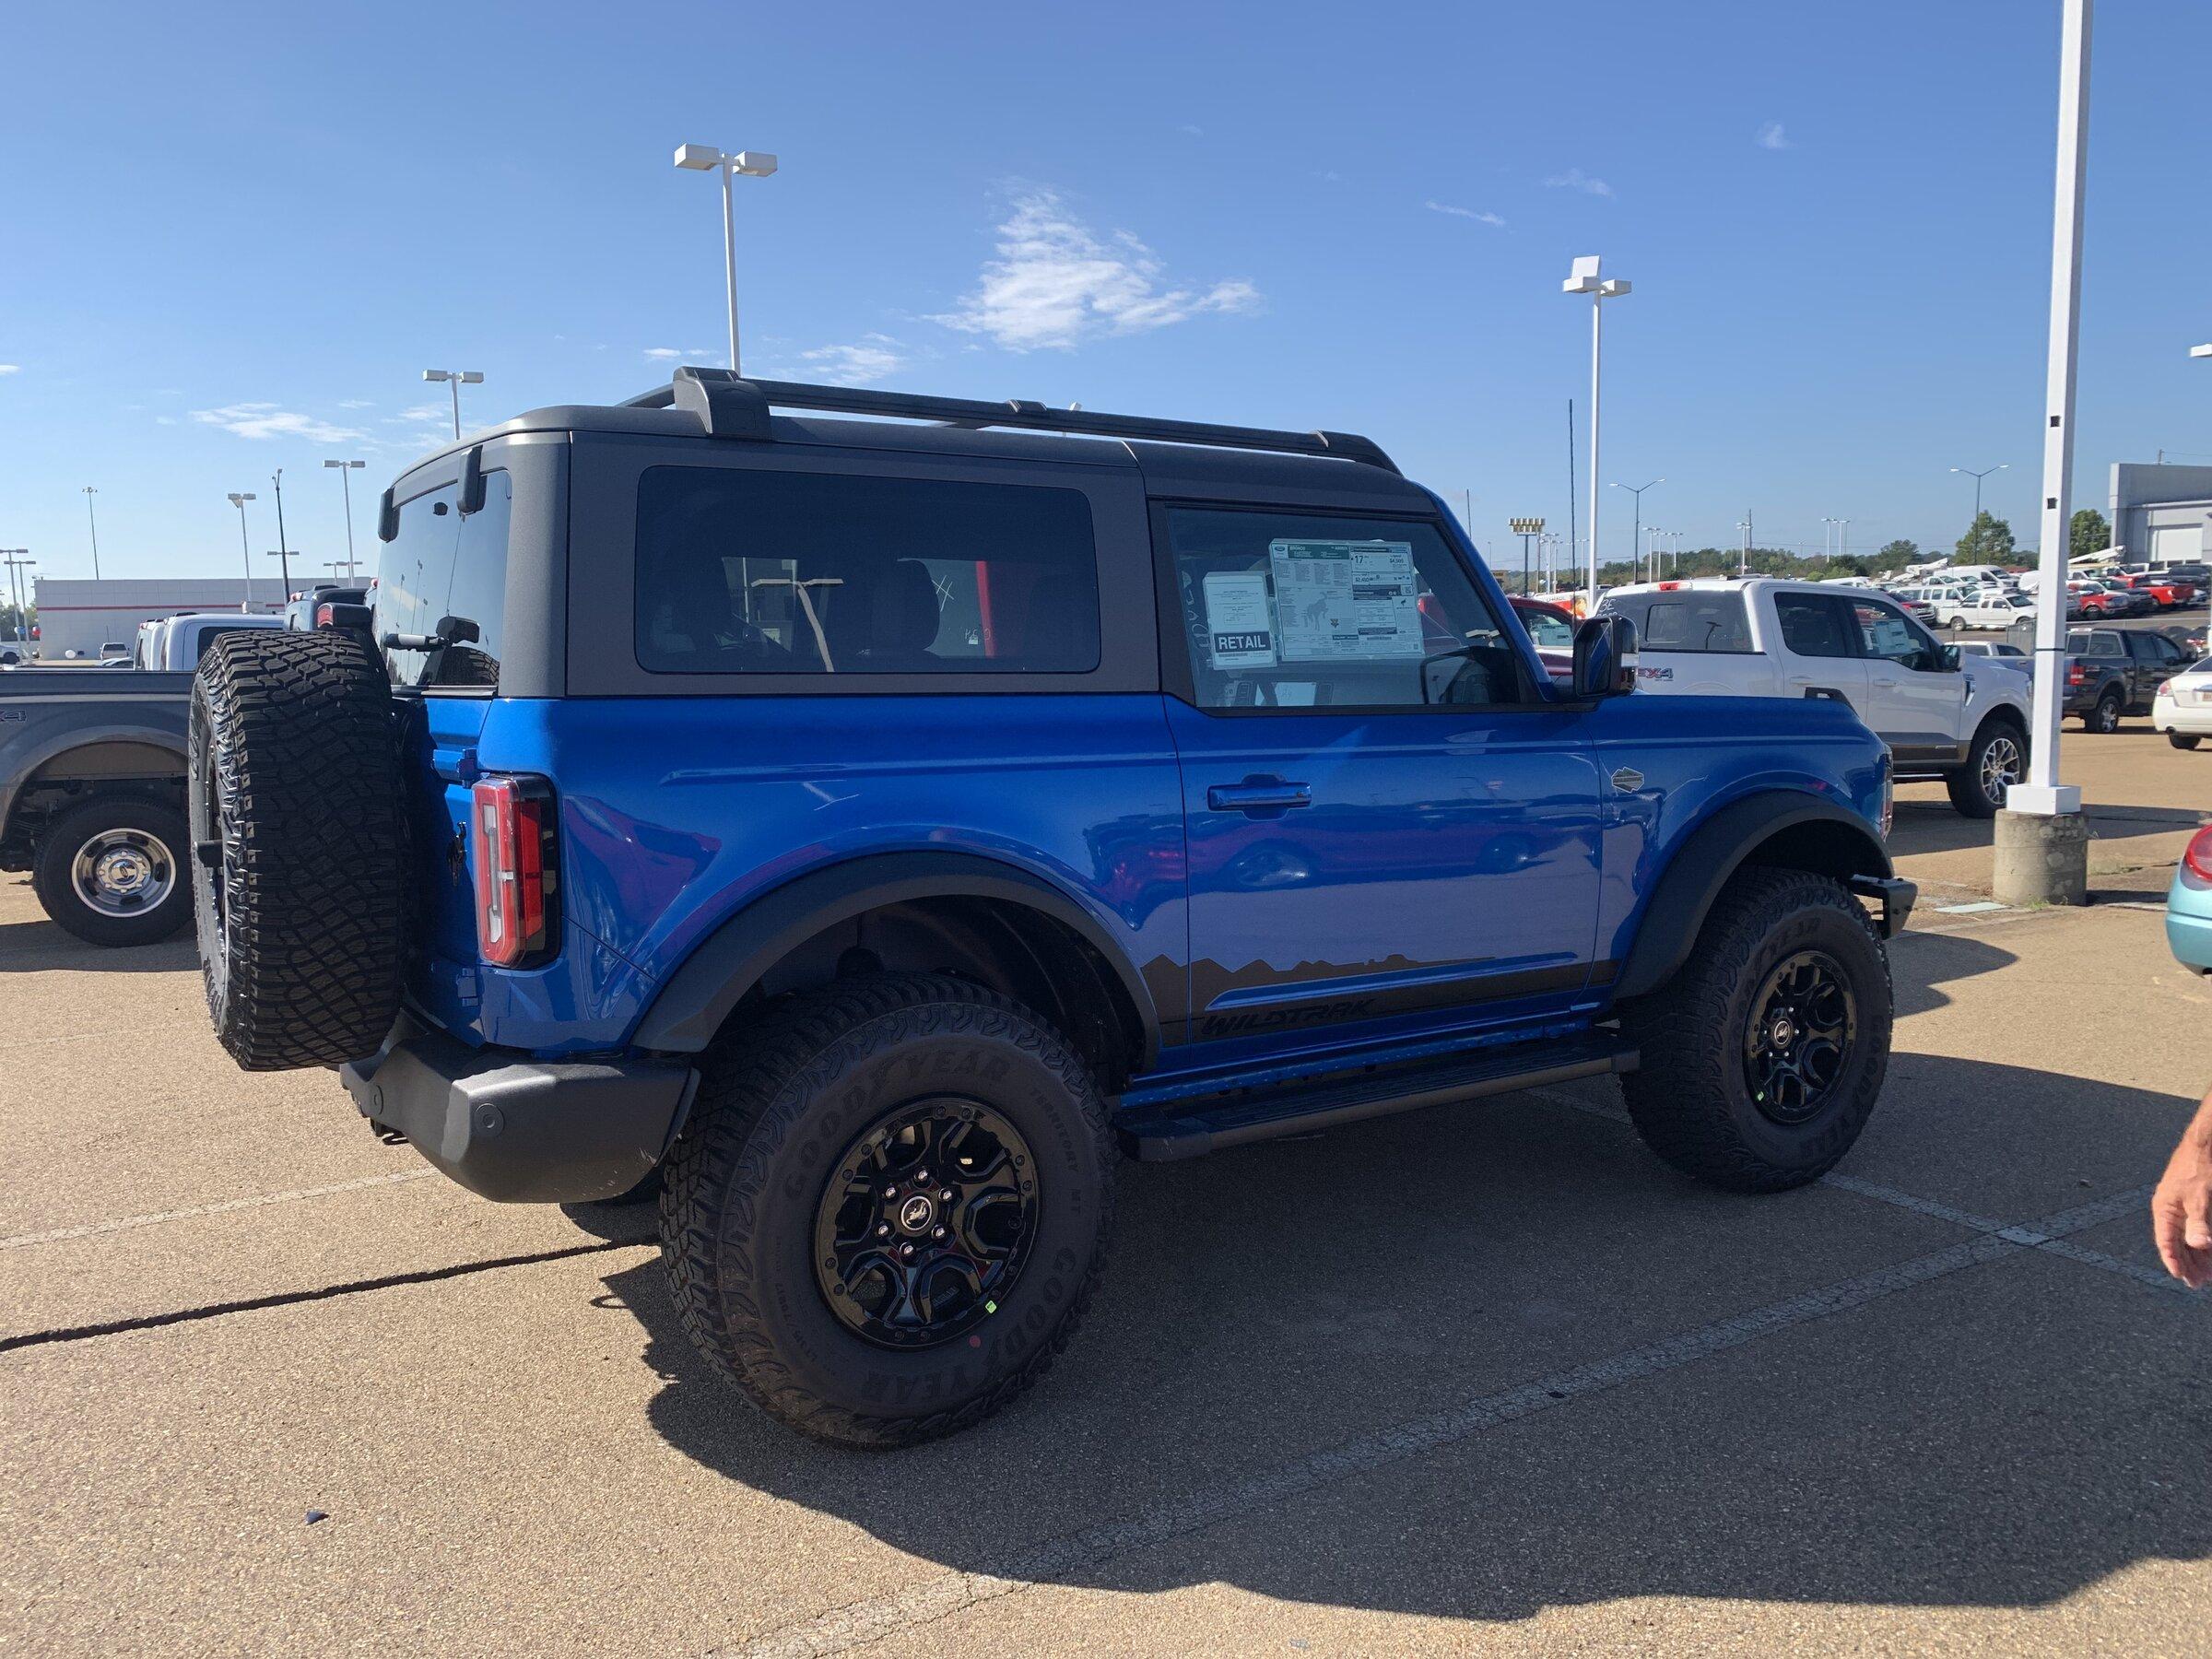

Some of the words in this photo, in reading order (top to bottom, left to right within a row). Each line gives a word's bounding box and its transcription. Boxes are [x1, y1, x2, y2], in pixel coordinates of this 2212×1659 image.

[1355, 555, 1364, 563] 17
[1218, 635, 1265, 650] RETAIL
[1202, 998, 1378, 1037] WILDTRAK
[783, 1049, 1014, 1200] GOODYEAR
